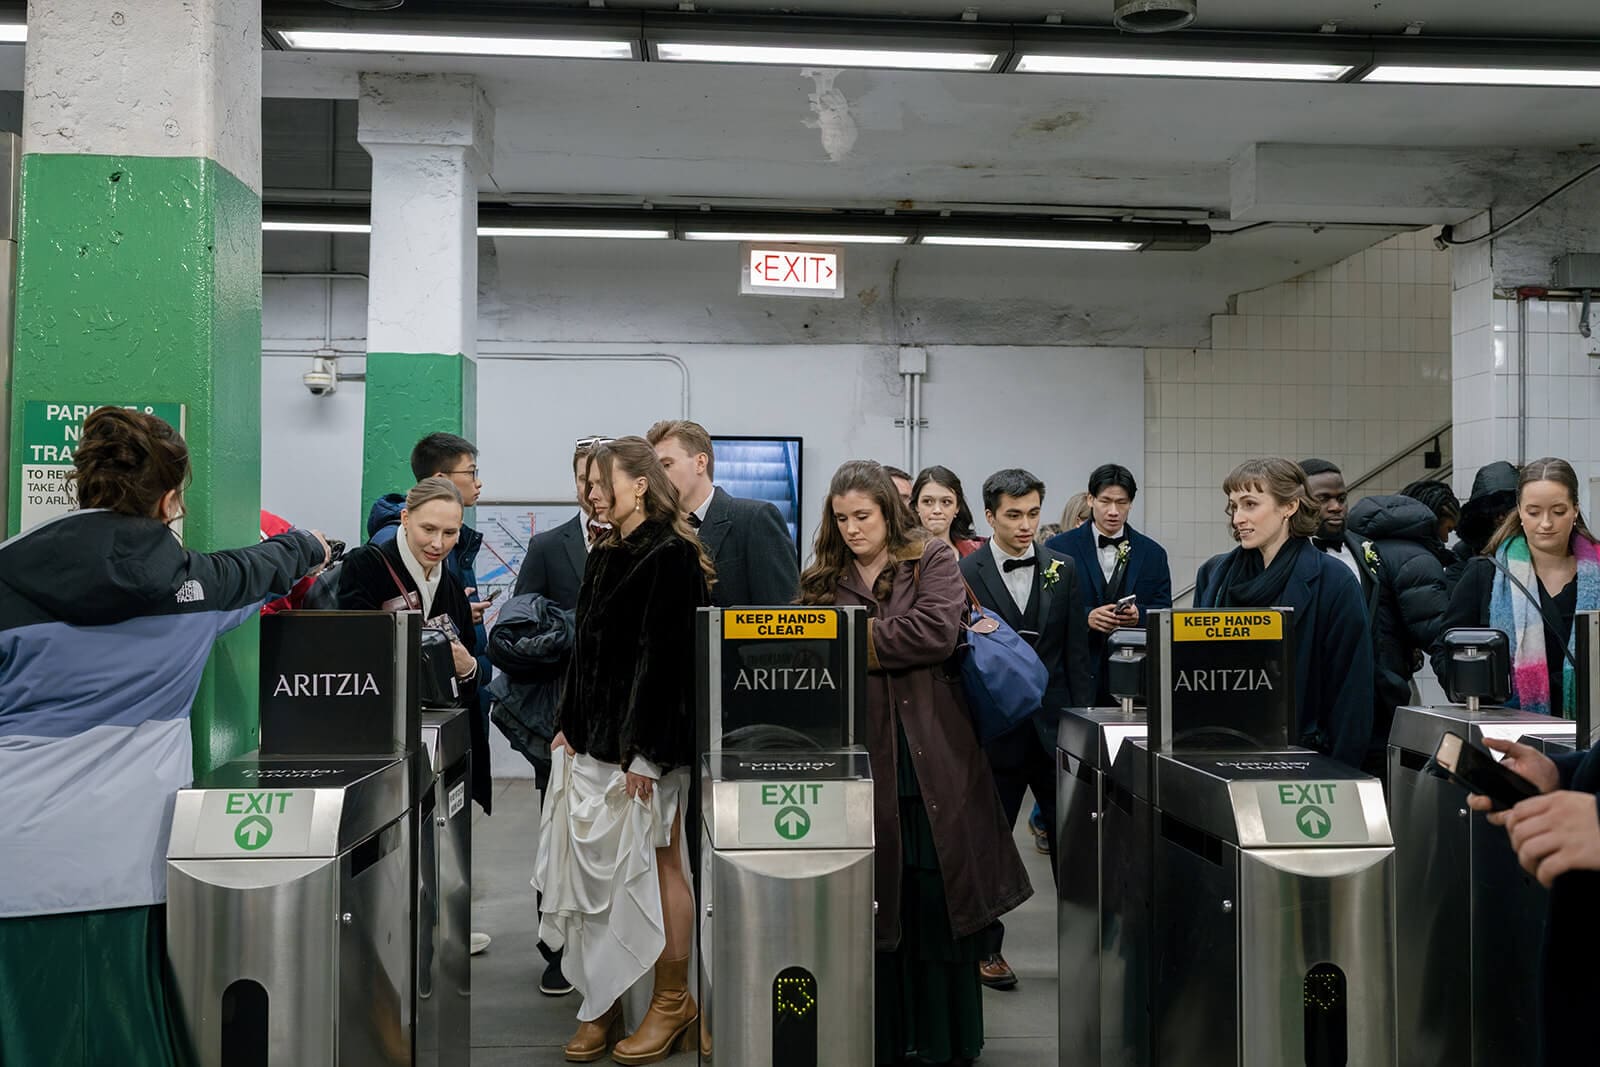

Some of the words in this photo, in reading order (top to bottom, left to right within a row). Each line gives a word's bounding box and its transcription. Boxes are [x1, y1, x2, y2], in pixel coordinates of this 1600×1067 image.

[765, 254, 826, 283] EXIT
[46, 405, 104, 421] PAR
[30, 445, 79, 461] TRA
[27, 469, 43, 479] TO
[27, 483, 55, 492] TAKE
[27, 495, 43, 505] TO
[736, 614, 774, 624] KEEP
[778, 614, 826, 624] HANDS
[1184, 616, 1221, 626] KEEP
[1225, 615, 1271, 626] HANDS
[757, 625, 804, 635] CLEAR
[1205, 627, 1250, 637] CLEAR
[273, 673, 380, 696] ARITZIA
[733, 668, 836, 690] ARITZIA
[1174, 669, 1273, 691] ARITZIA
[761, 784, 824, 805] EXIT
[1278, 784, 1337, 804] EXIT
[225, 792, 294, 814] EXIT
